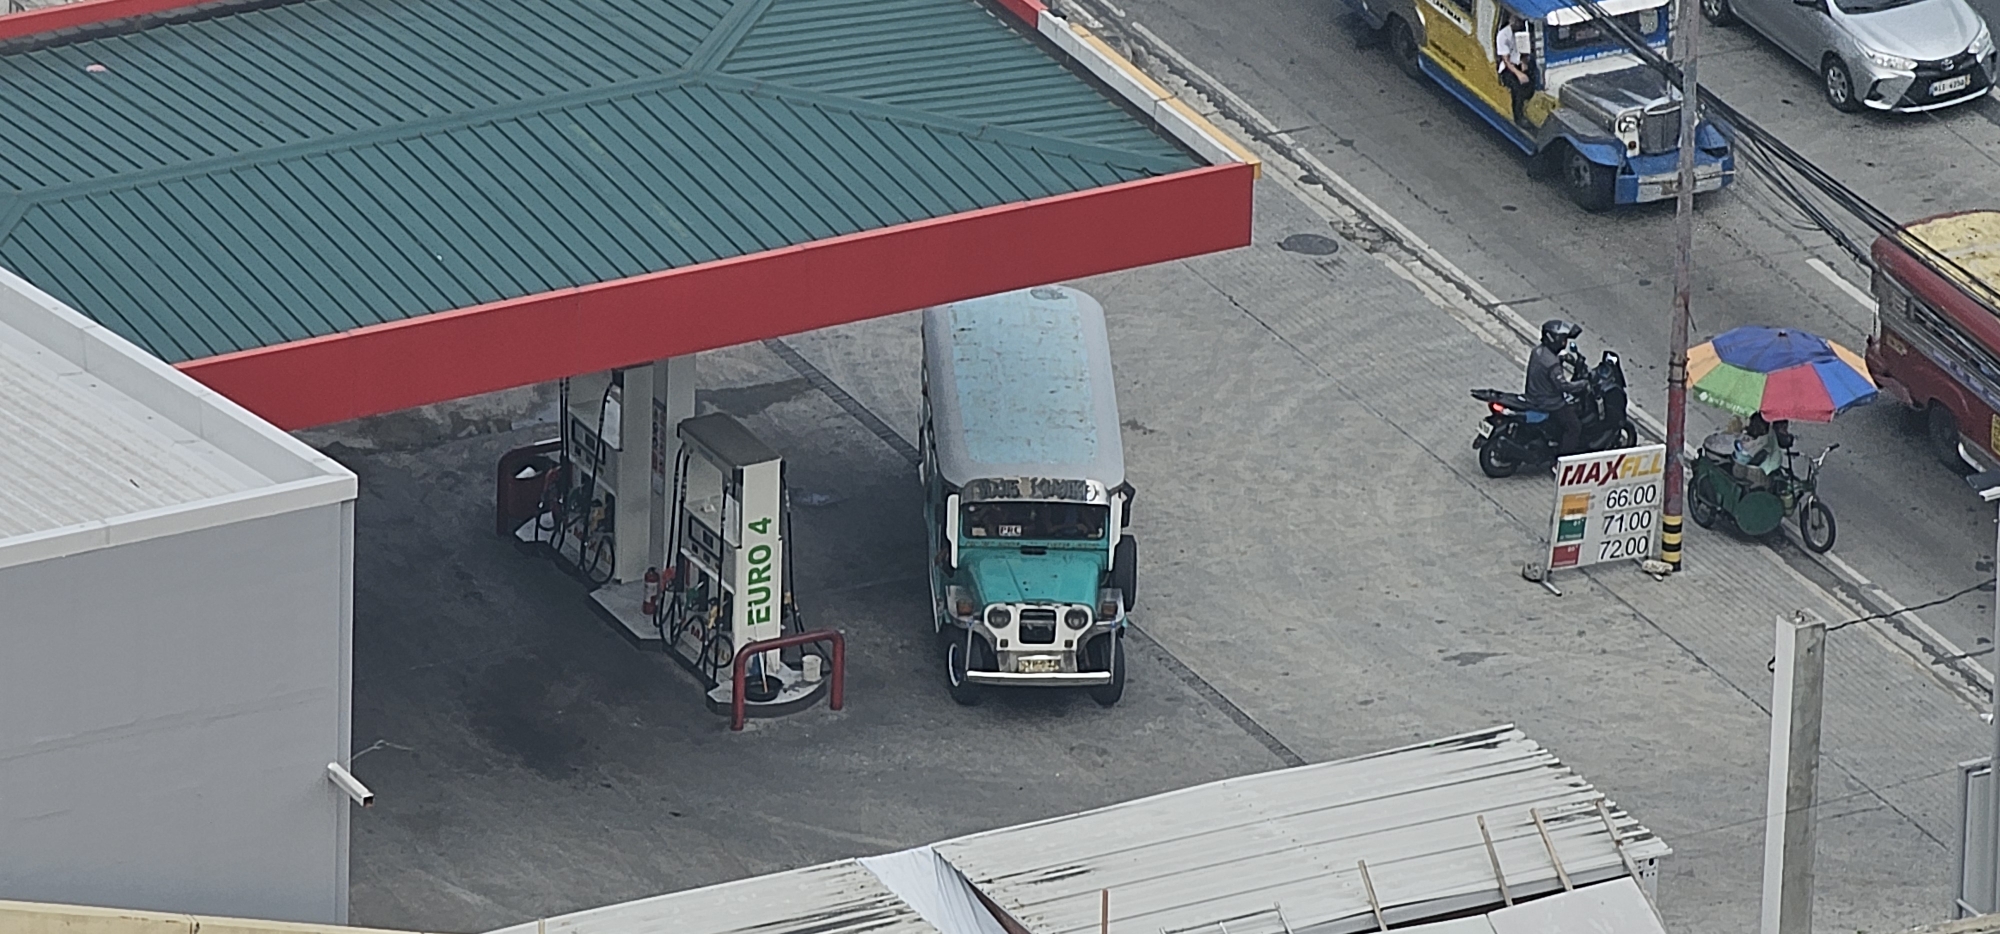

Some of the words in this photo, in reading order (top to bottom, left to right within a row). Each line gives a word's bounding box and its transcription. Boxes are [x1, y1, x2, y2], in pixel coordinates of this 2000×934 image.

[1606, 484, 1656, 509] 66.00
[748, 517, 772, 534] 4
[1603, 510, 1652, 535] 71.00
[1600, 535, 1648, 560] 72.00
[747, 543, 772, 627] EURO
